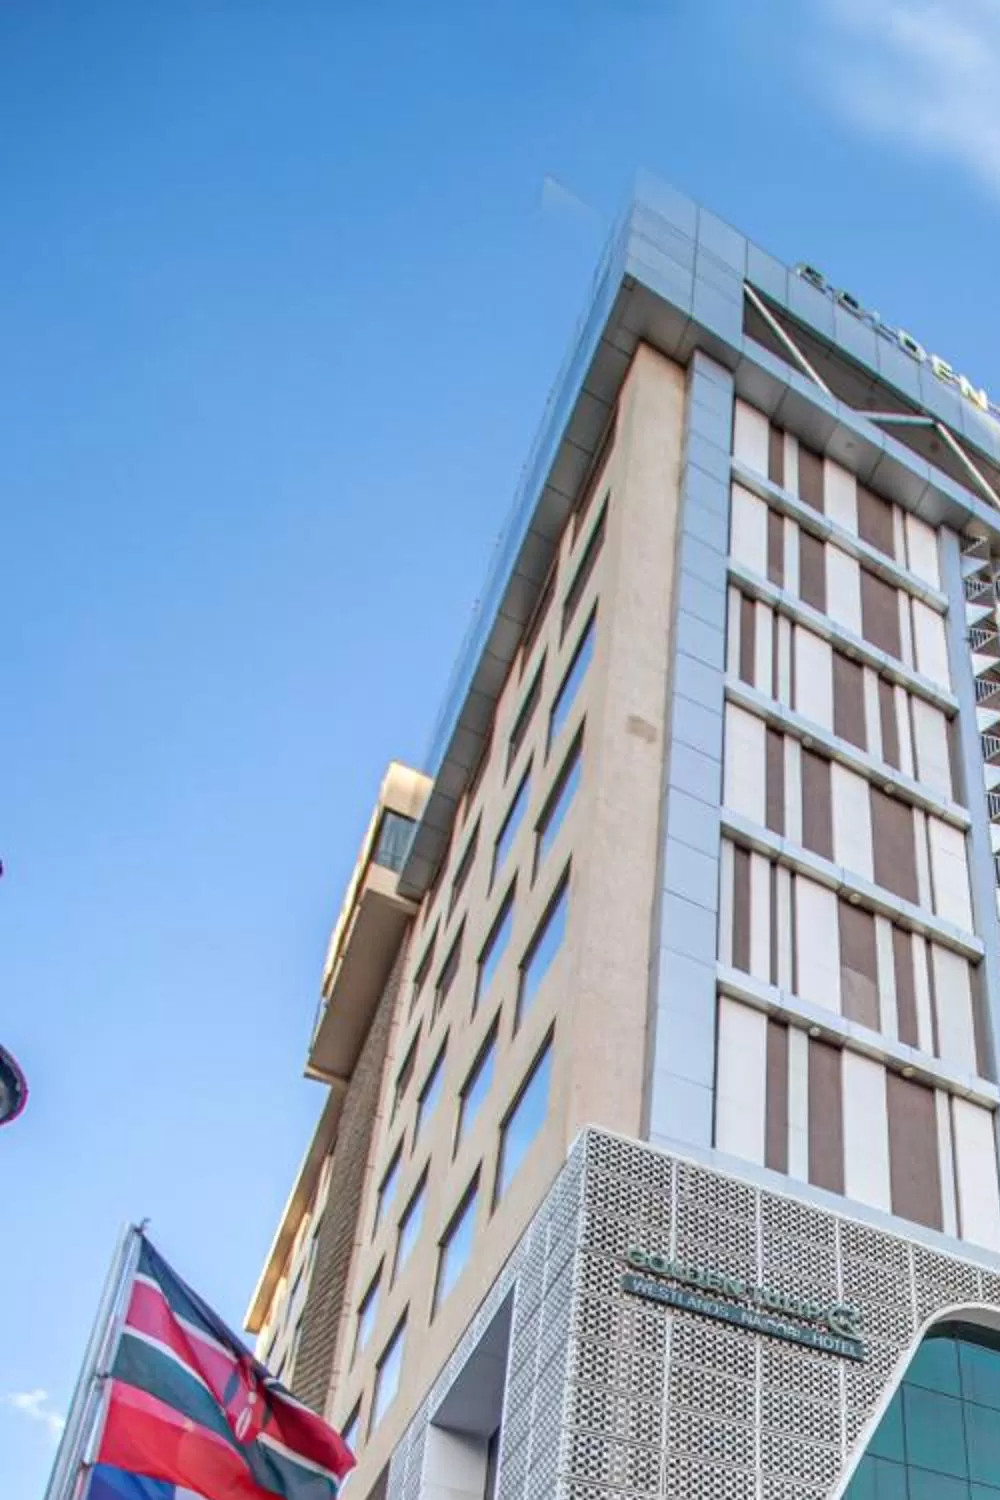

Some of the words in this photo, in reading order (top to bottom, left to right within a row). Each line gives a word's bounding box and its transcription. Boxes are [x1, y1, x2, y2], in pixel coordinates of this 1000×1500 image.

[628, 1248, 741, 1297] GOLDEN
[752, 1284, 821, 1319] TULIP
[633, 1279, 729, 1319] WESTLANDS
[813, 1333, 858, 1358] HOTEL
